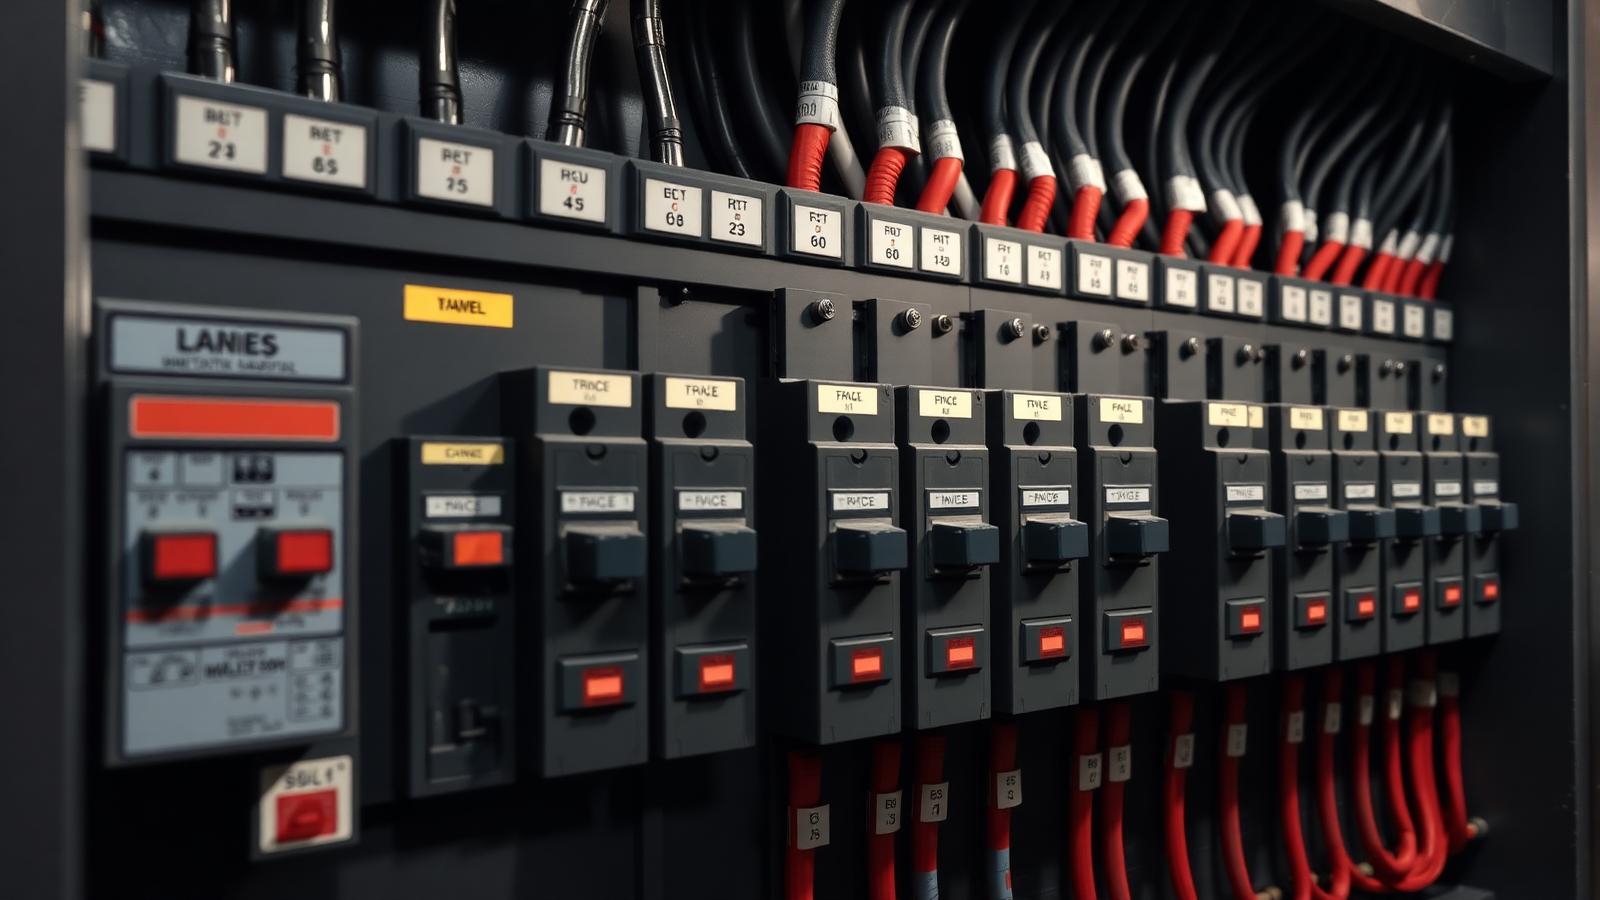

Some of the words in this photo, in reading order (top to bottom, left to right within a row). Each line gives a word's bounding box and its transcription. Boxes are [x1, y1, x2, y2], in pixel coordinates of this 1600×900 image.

[563, 197, 584, 211] 45
[729, 222, 745, 237] 23
[810, 235, 827, 249] 60
[885, 248, 900, 261] 60
